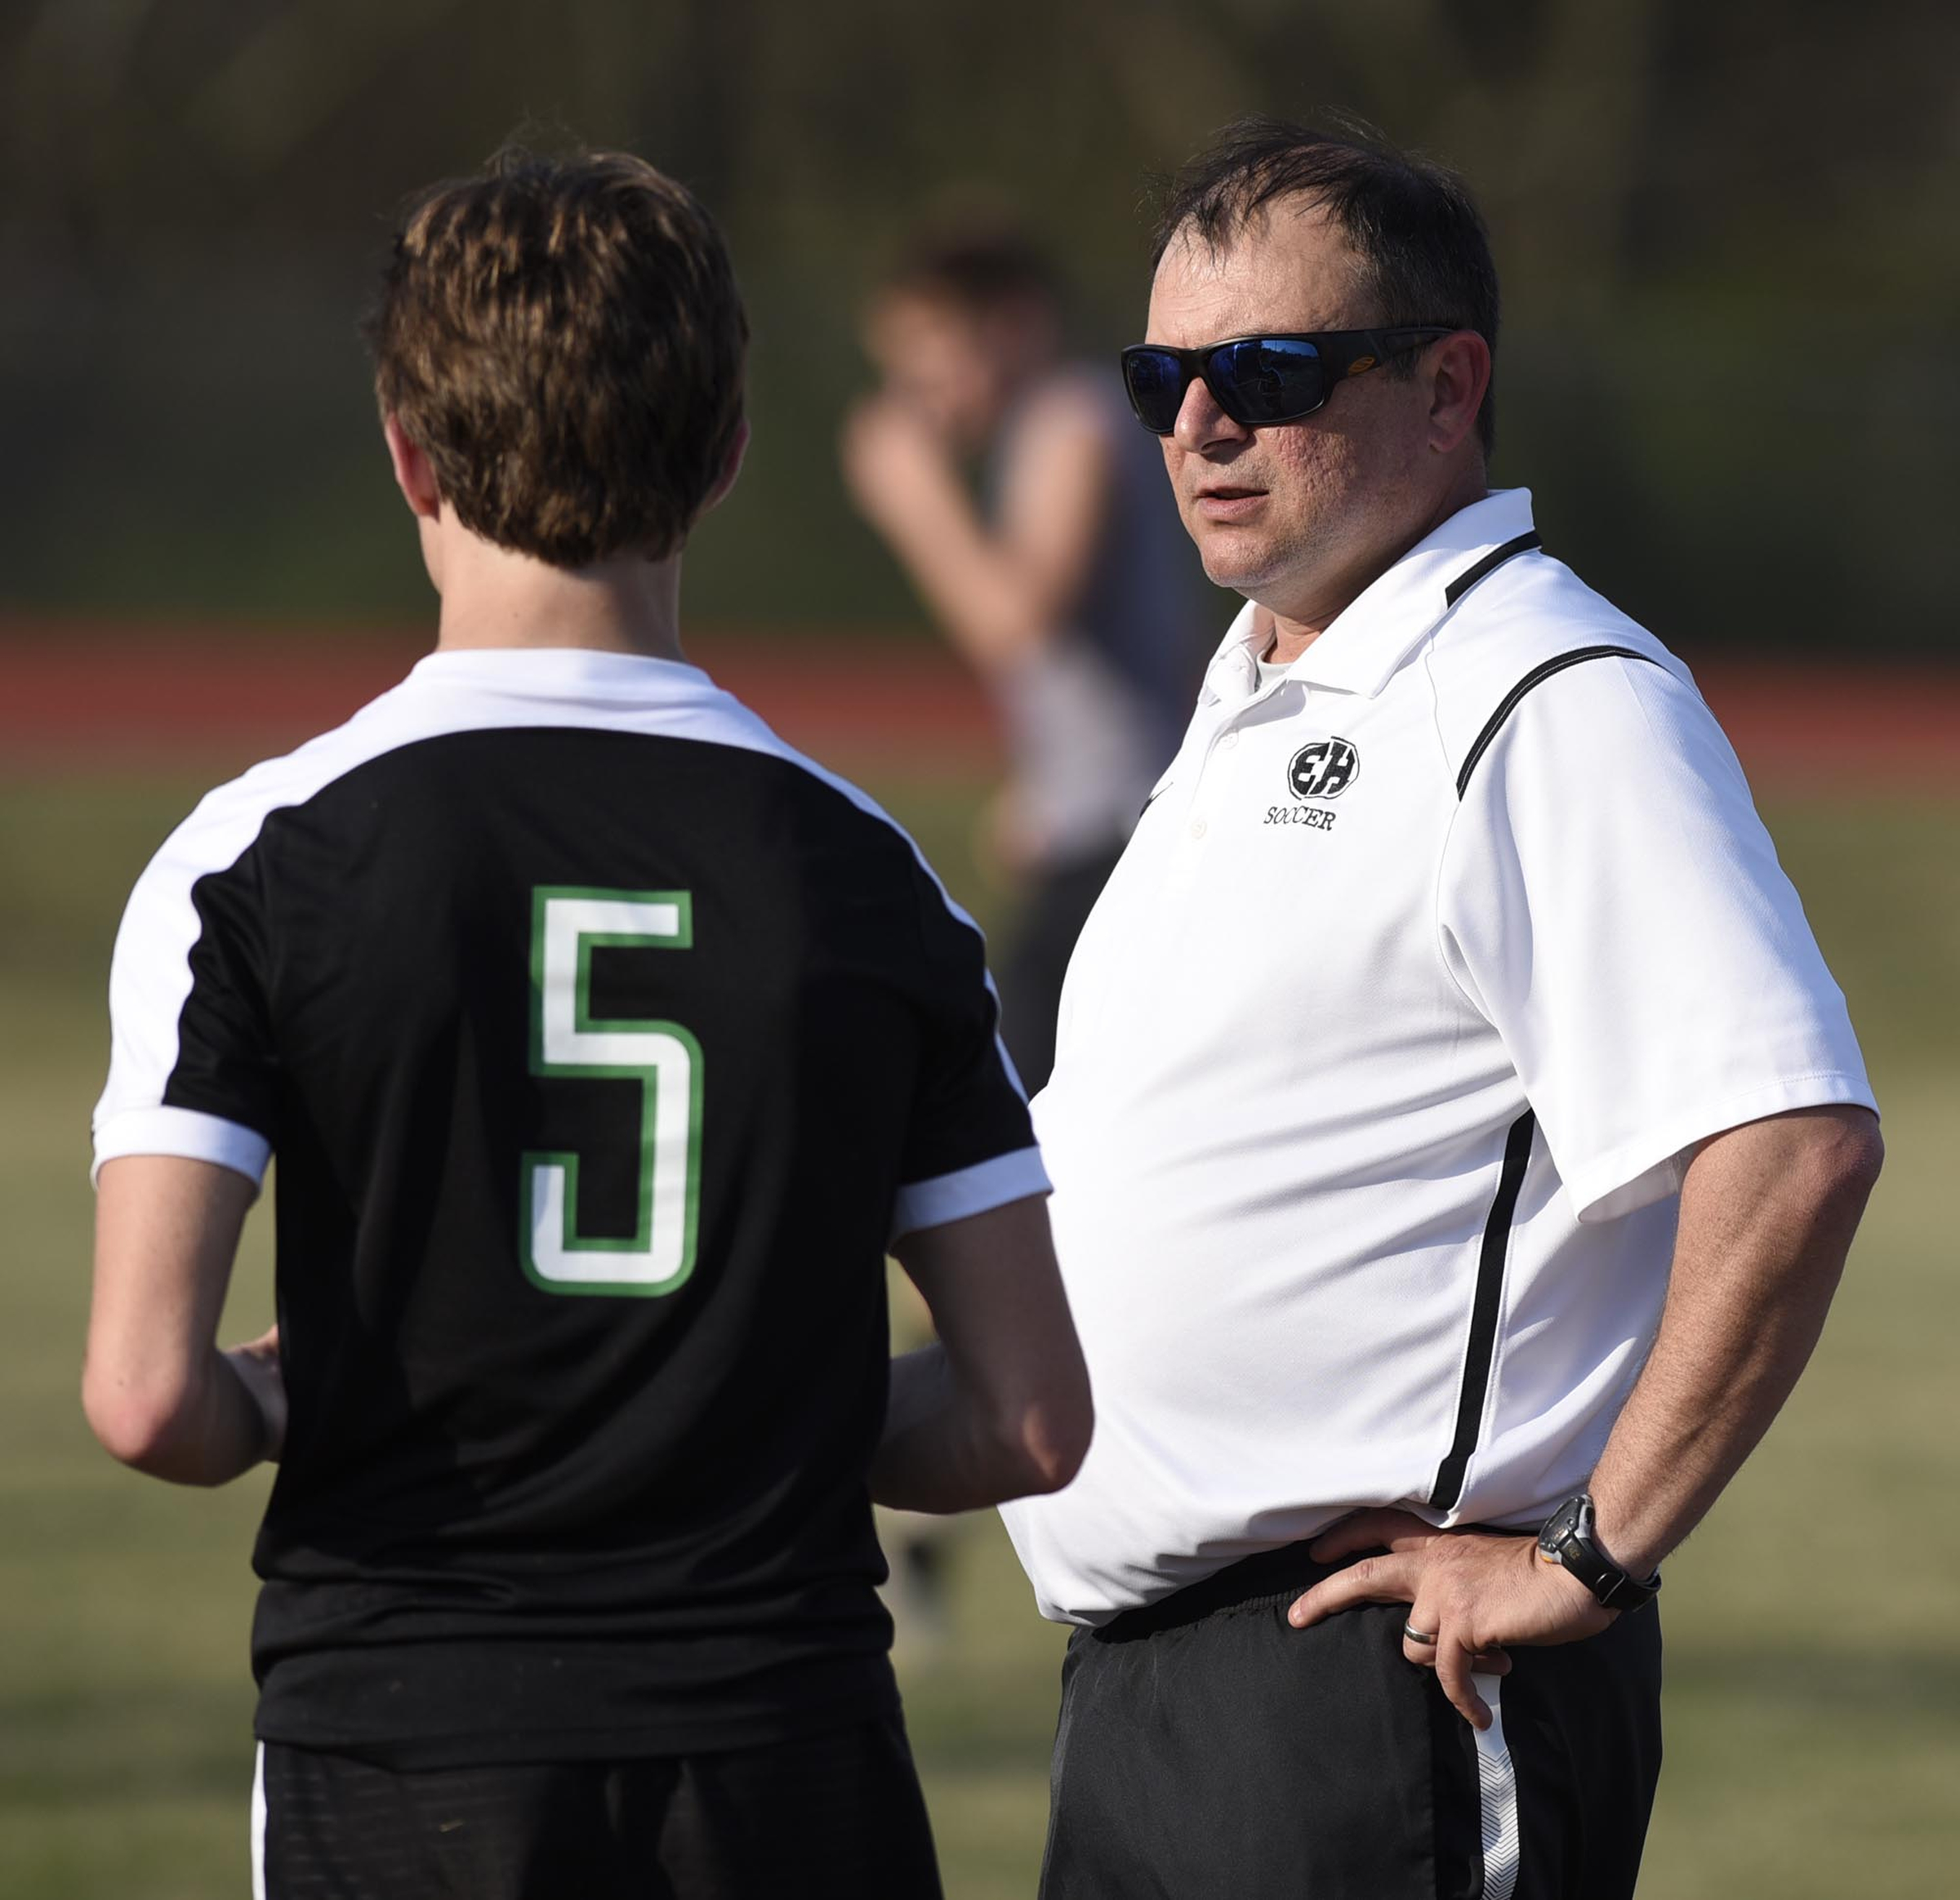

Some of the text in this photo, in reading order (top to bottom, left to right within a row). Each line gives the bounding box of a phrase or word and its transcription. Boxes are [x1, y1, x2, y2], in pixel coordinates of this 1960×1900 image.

[1291, 741, 1356, 795] EH
[1263, 806, 1335, 830] SOCCER
[519, 886, 704, 1297] 5
